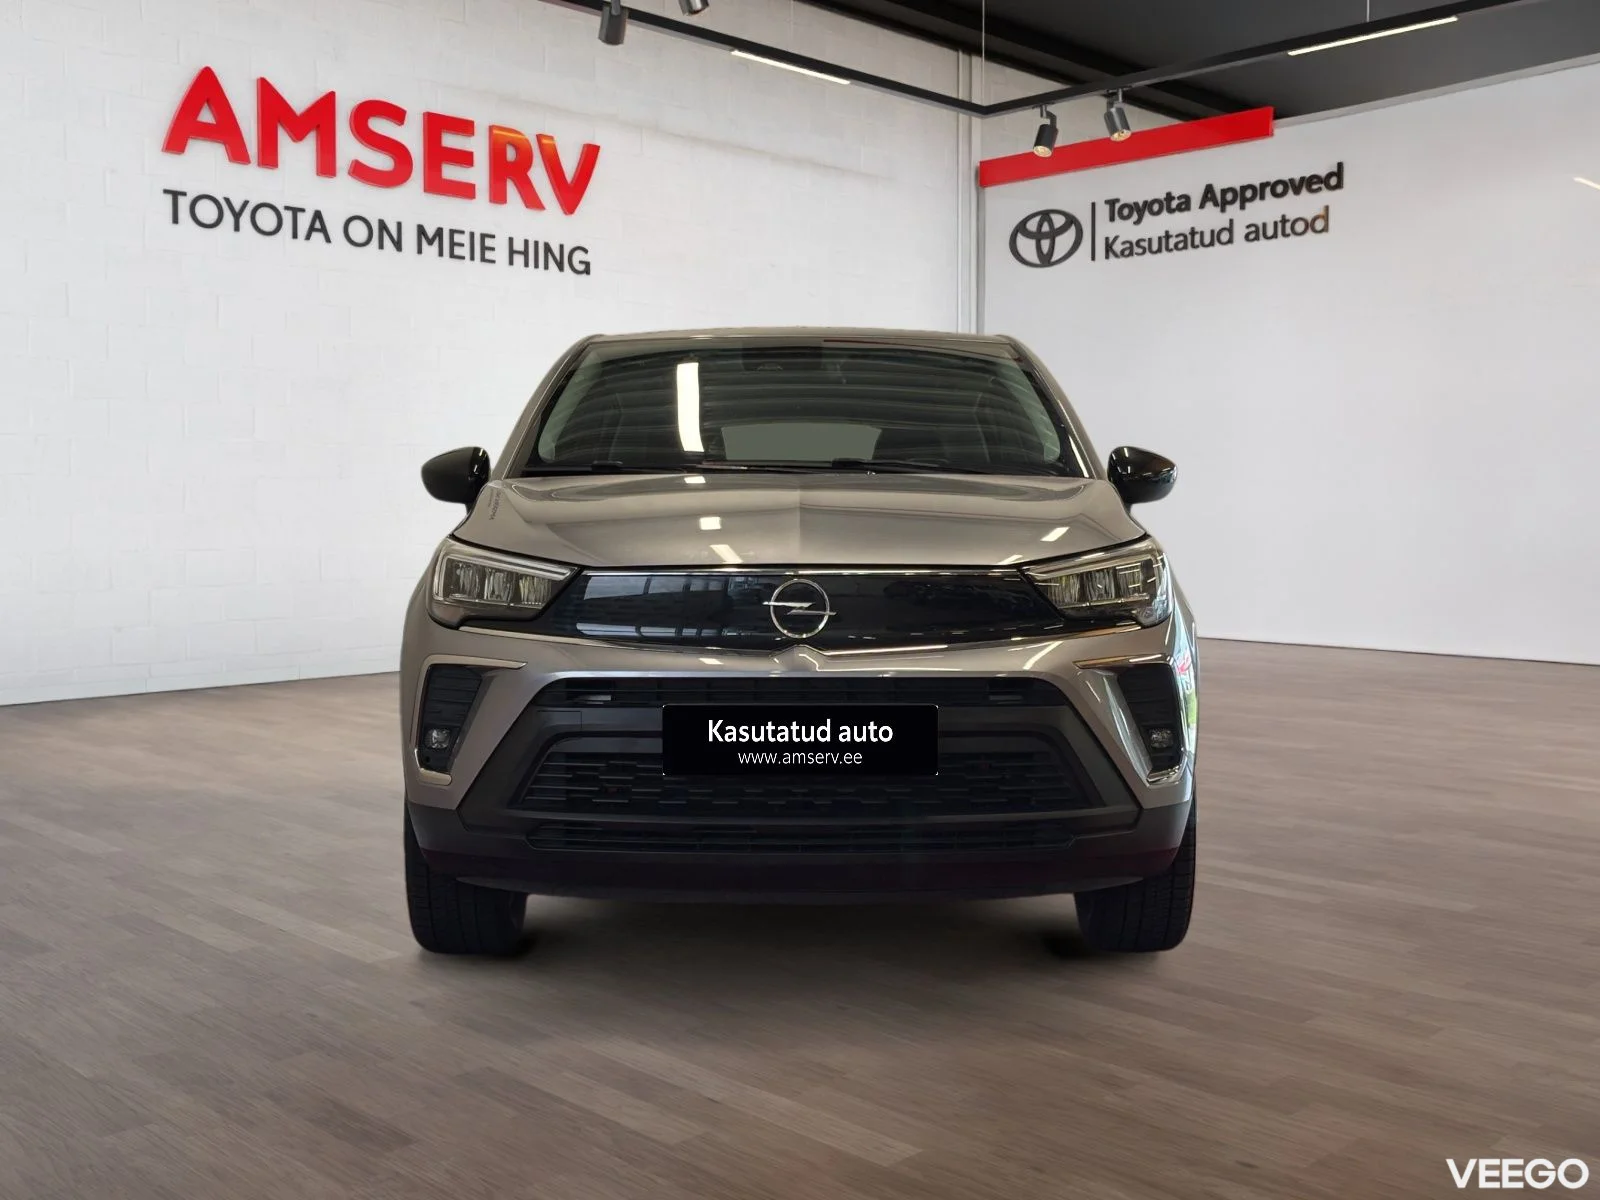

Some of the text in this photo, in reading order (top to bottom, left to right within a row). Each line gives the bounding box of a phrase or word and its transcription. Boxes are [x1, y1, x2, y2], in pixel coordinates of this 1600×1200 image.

[161, 66, 600, 215] AMSERV
[1104, 161, 1344, 226] Toyota Approved
[163, 188, 591, 276] TOYOTA ON MEIE HING
[1104, 205, 1330, 260] Kasutatud autod
[708, 718, 894, 743] Kasutatud auto
[738, 751, 863, 765] www.amserv.ee
